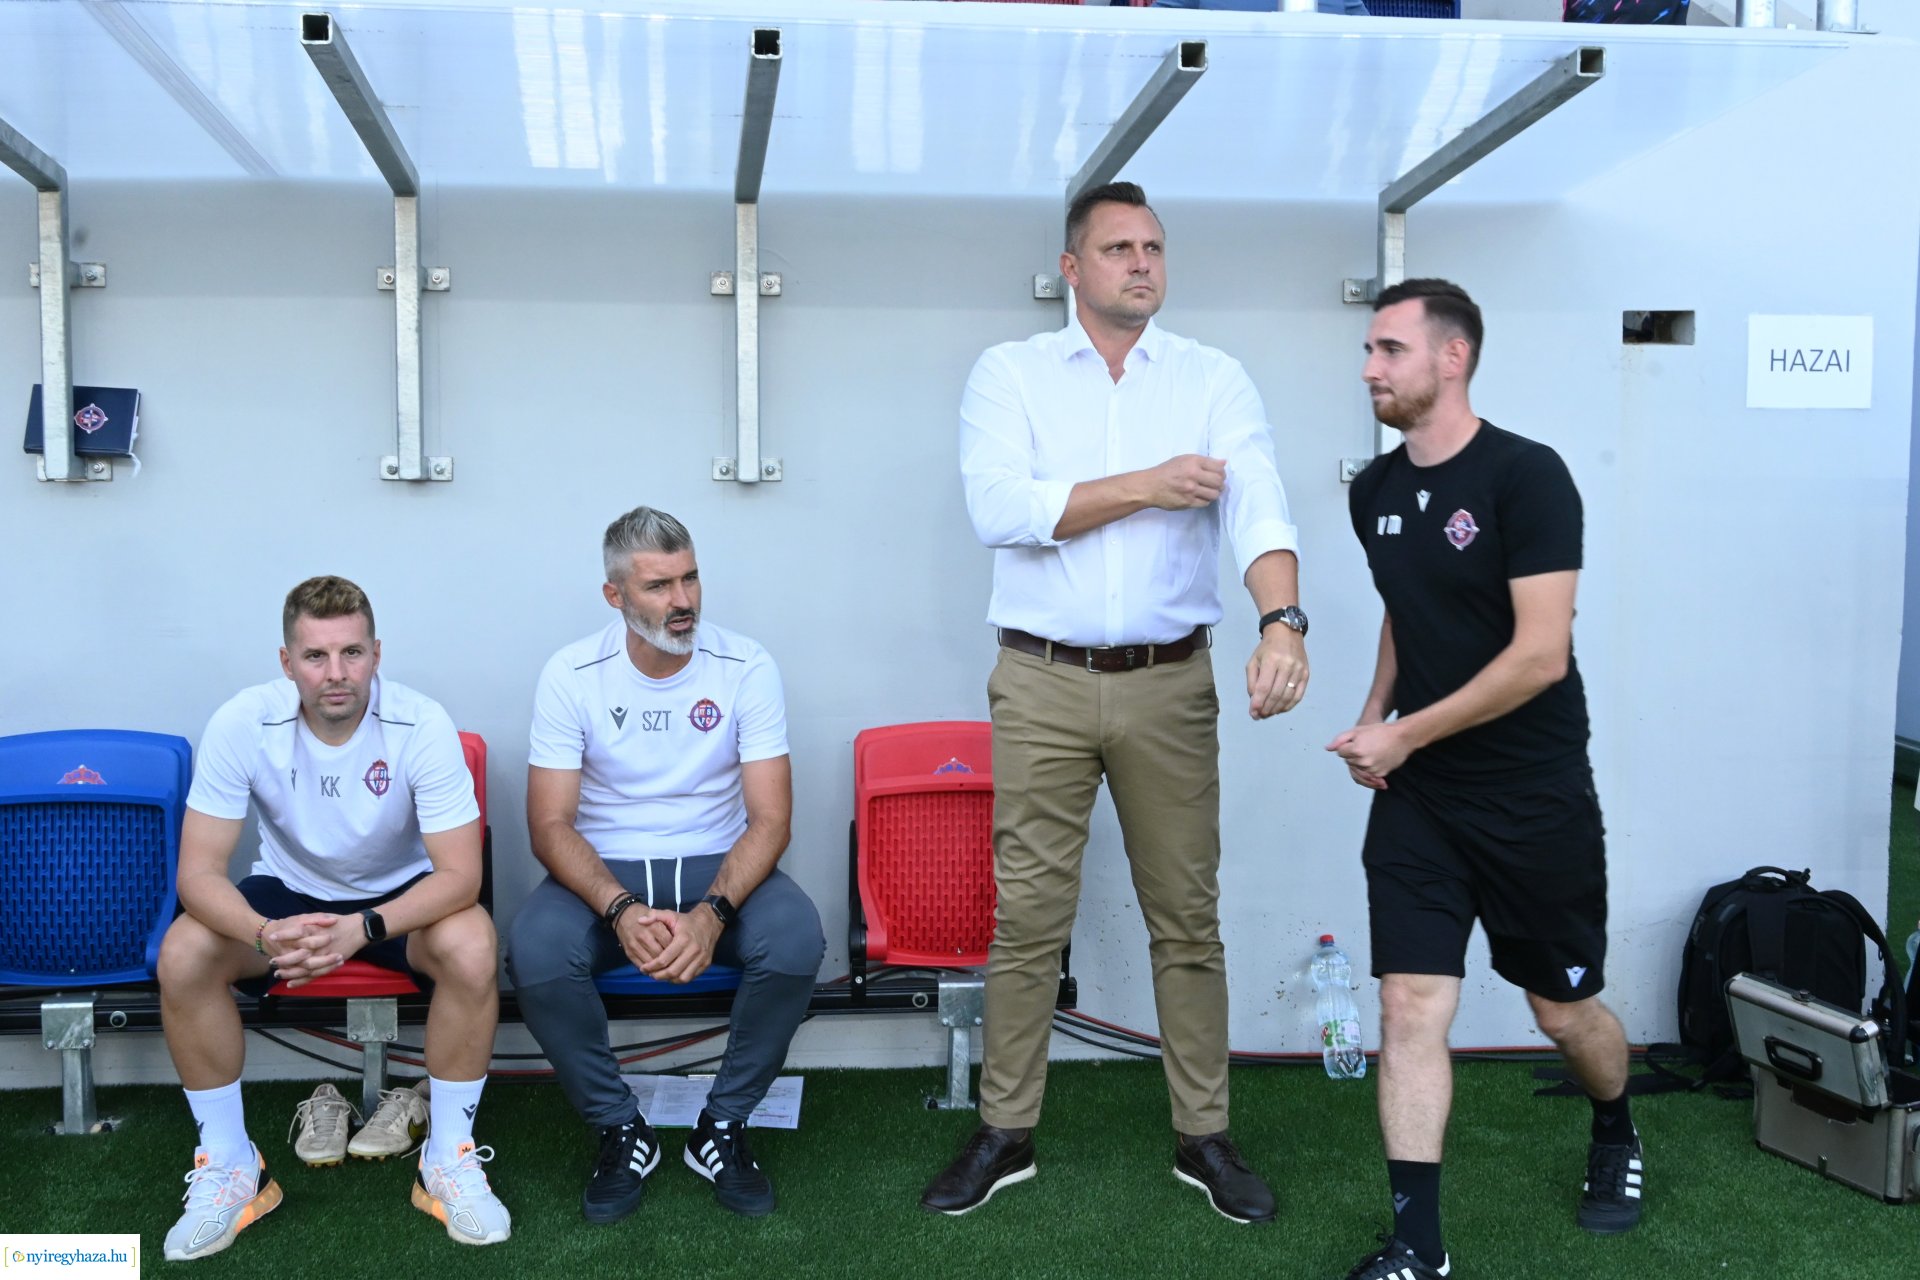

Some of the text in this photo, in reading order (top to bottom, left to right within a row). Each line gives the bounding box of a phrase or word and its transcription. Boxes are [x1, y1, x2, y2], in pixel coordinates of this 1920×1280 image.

[1770, 348, 1850, 372] HAZAI
[642, 710, 672, 731] SZT
[320, 775, 341, 798] KK
